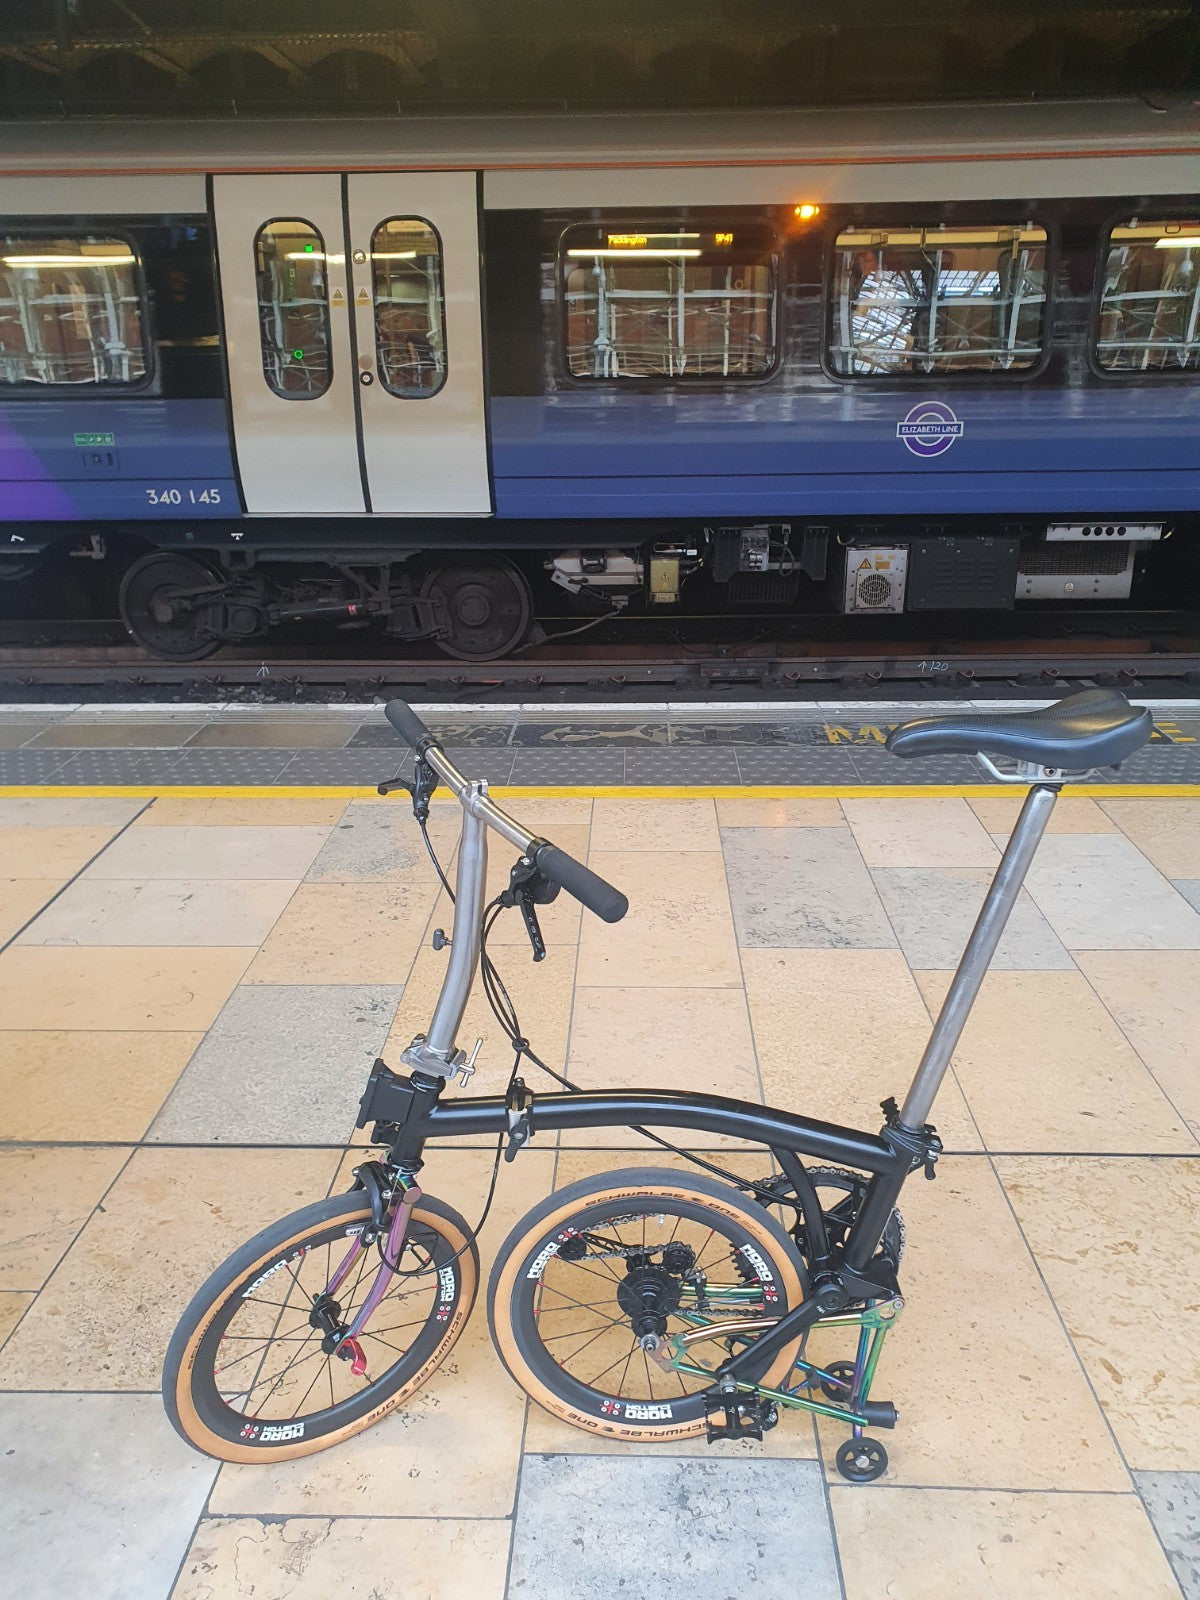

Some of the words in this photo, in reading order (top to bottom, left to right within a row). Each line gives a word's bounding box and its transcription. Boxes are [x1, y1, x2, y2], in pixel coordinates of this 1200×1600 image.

[901, 425, 940, 433] ELIZABETH
[941, 425, 959, 433] LINE
[145, 489, 182, 505] 340
[189, 488, 221, 504] 145
[585, 1190, 686, 1206] SCHWALBE
[708, 1202, 740, 1219] ONE
[526, 1241, 559, 1279] MORO
[740, 1243, 774, 1281] MORO
[442, 1266, 455, 1301] MORO
[412, 1311, 464, 1387] SCHWALBE
[367, 1399, 396, 1421] ONE
[625, 1403, 672, 1411] CUSTOM
[625, 1409, 673, 1420] MORO
[263, 1422, 304, 1432] CUSTOM
[567, 1411, 598, 1428] ONE
[259, 1427, 304, 1441] MORO
